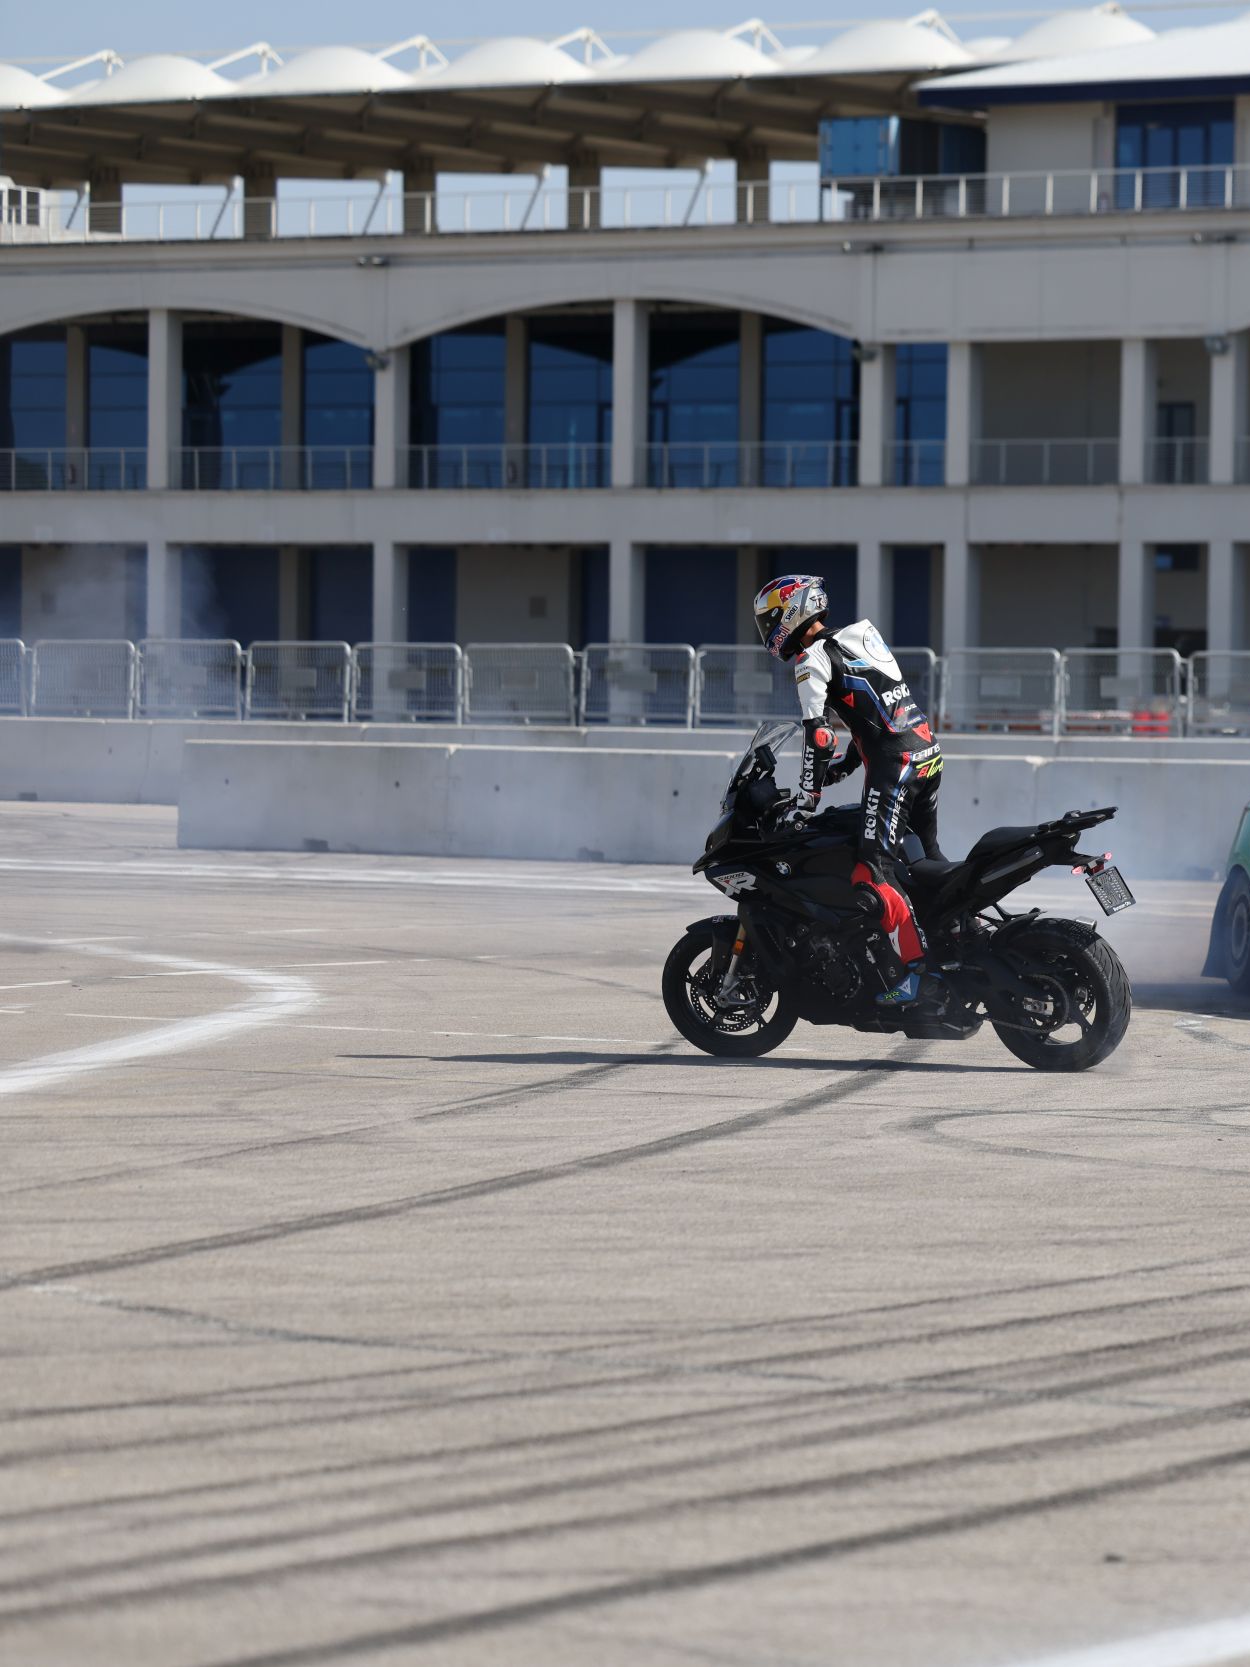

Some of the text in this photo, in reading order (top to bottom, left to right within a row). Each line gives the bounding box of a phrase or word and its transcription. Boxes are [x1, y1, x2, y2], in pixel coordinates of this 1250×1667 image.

[775, 625, 790, 643] Bull
[785, 605, 799, 621] SHOEI
[802, 745, 815, 790] ROKiT
[864, 787, 881, 840] ROKiT
[888, 785, 909, 845] DAINESE
